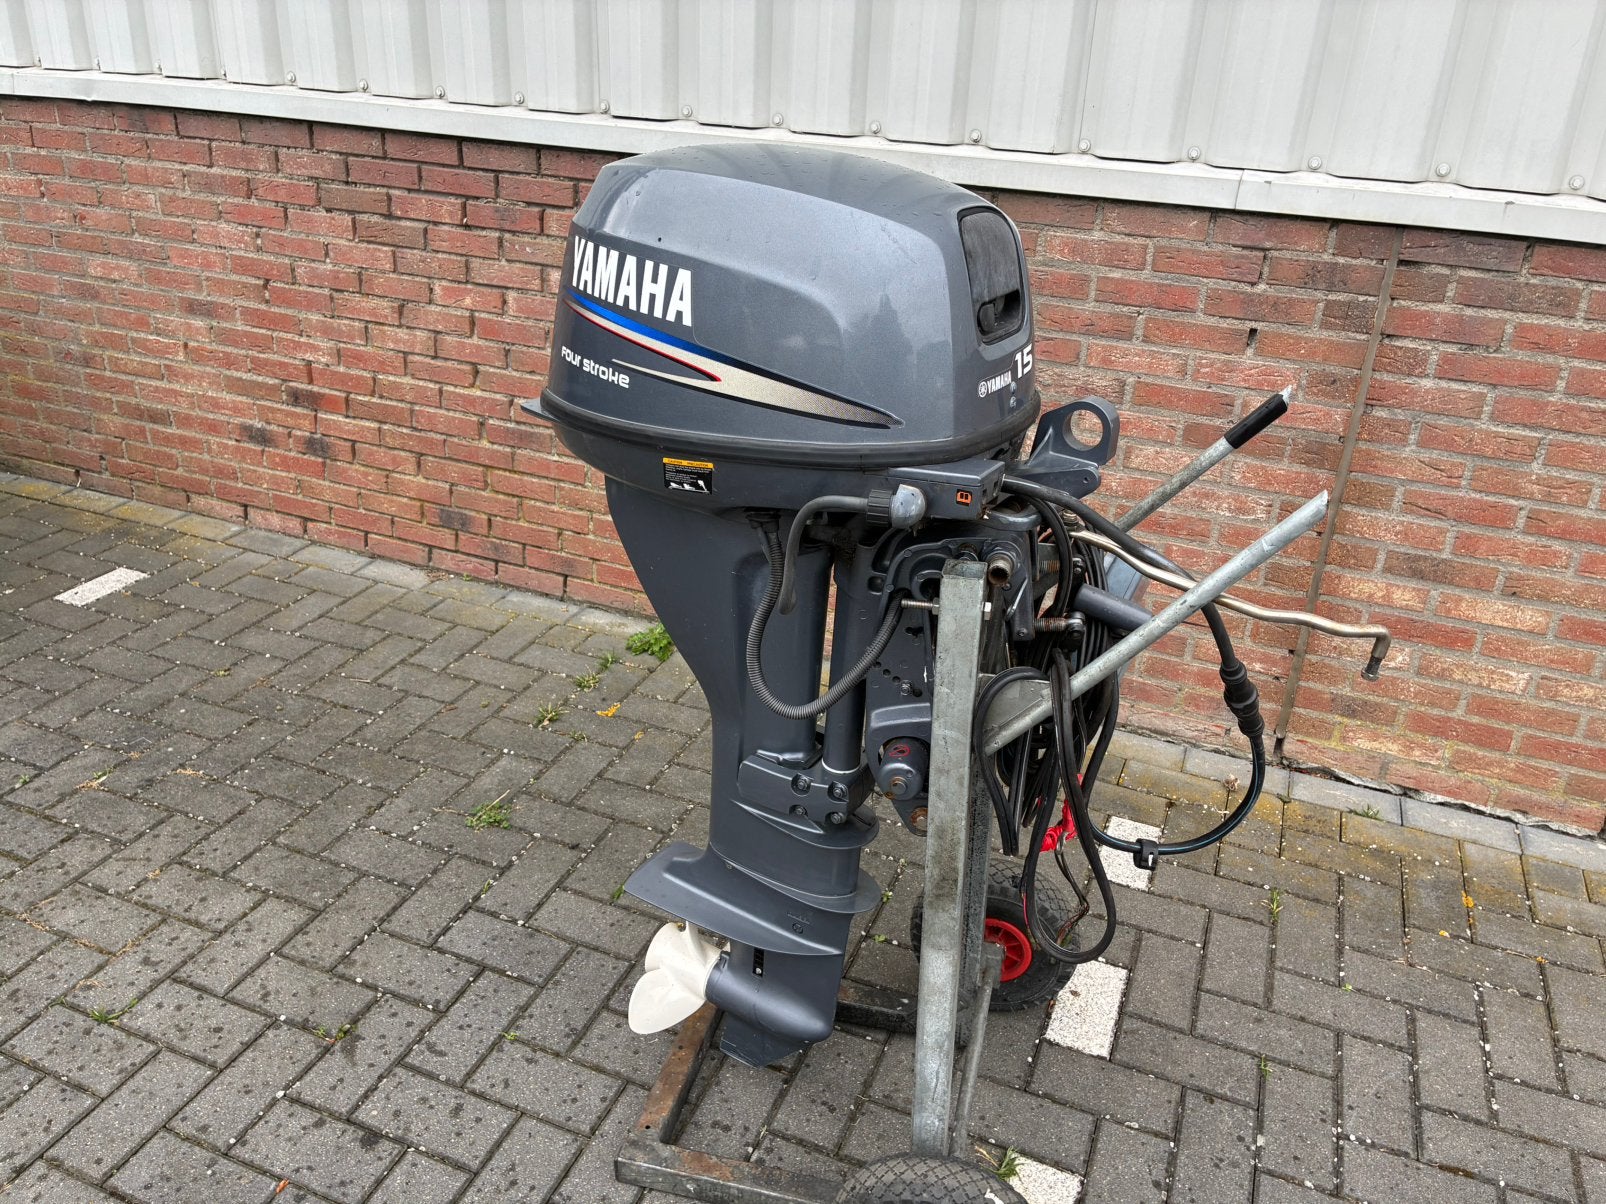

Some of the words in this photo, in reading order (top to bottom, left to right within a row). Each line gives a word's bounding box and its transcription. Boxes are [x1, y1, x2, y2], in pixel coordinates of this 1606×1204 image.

[572, 235, 692, 327] YAMAHA
[1014, 343, 1033, 379] 15
[986, 370, 1012, 394] YAMAHA
